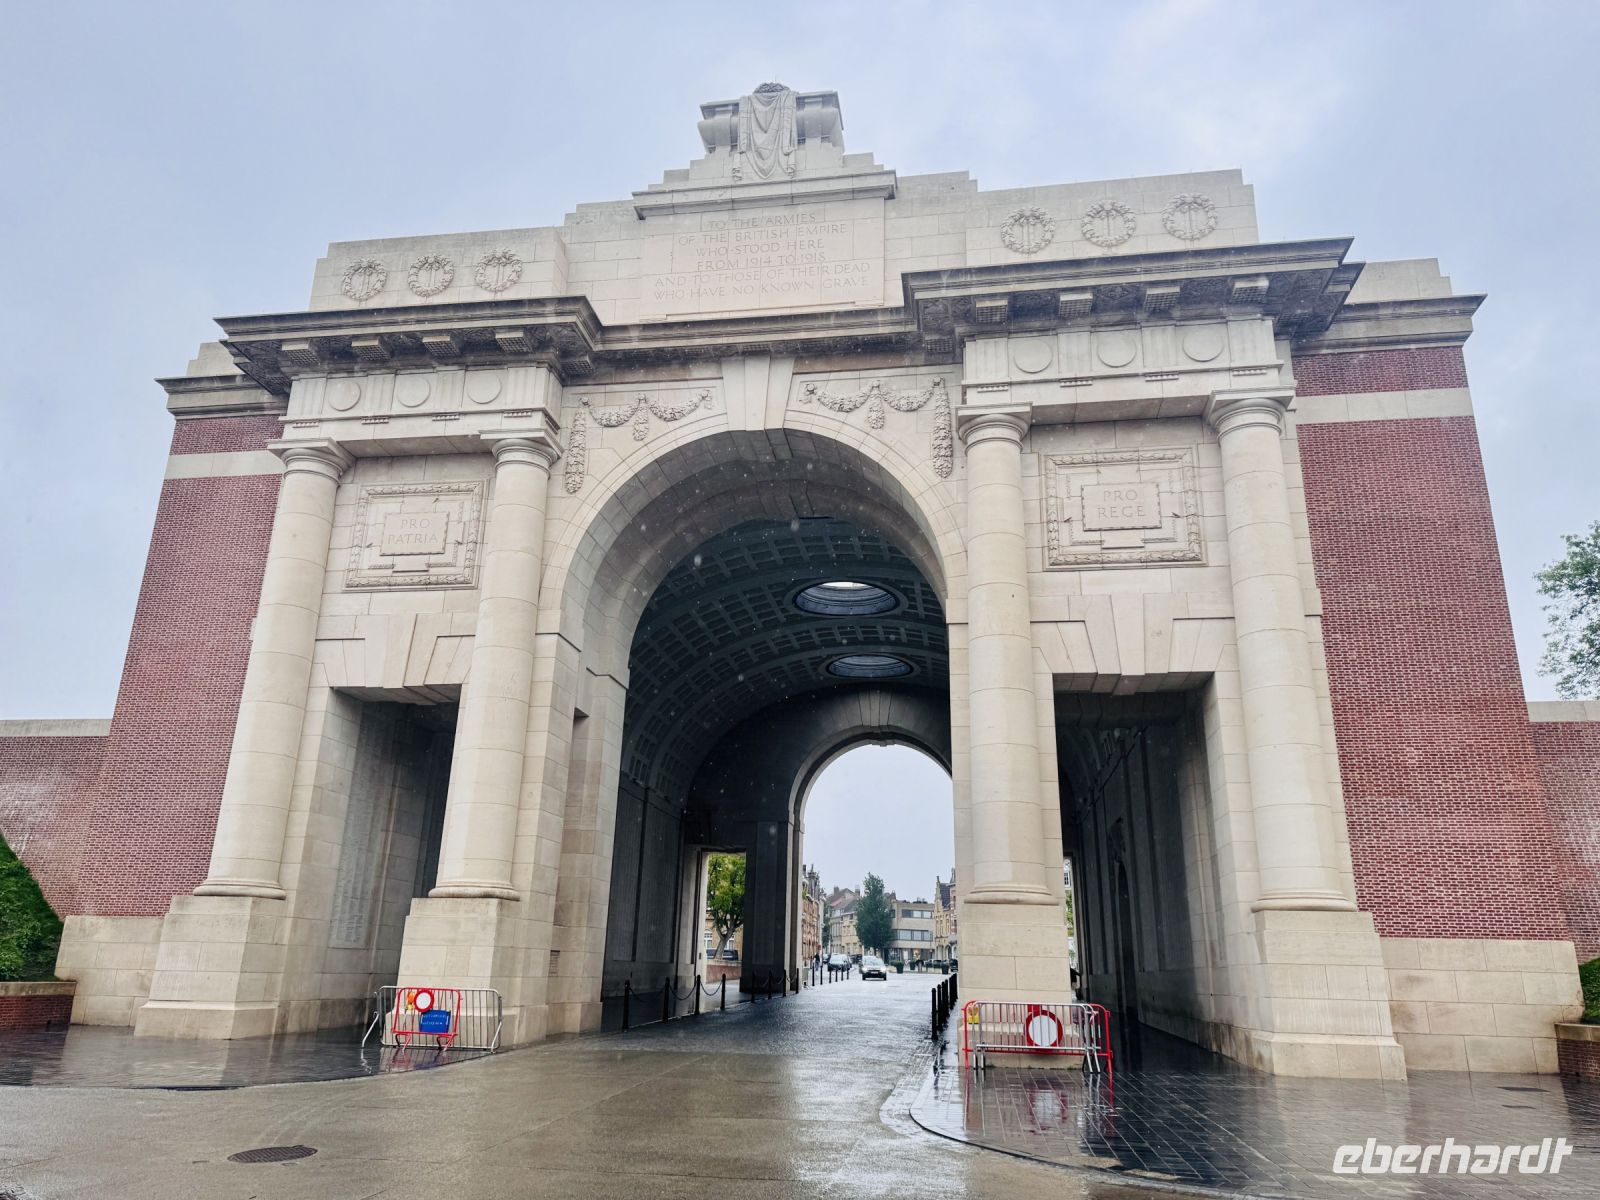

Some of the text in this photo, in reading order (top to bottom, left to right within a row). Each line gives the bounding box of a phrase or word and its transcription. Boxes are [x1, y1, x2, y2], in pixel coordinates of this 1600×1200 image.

[708, 213, 816, 230] TO THE ARMIES
[678, 224, 846, 246] OF THE BRITISH EMPIRE
[696, 239, 825, 257] WHO STOOD HERE
[696, 259, 739, 271] FROM
[746, 256, 772, 269] 1914
[778, 255, 795, 266] TO
[655, 262, 871, 287] AND TO THOSE OF THEIR DEAD
[654, 276, 869, 301] WHO HAVE NO KNOWN GRAVE
[1103, 489, 1138, 502] PRO
[1098, 505, 1145, 518] REGE
[401, 518, 431, 530] PRO
[387, 533, 439, 545] PATRIA
